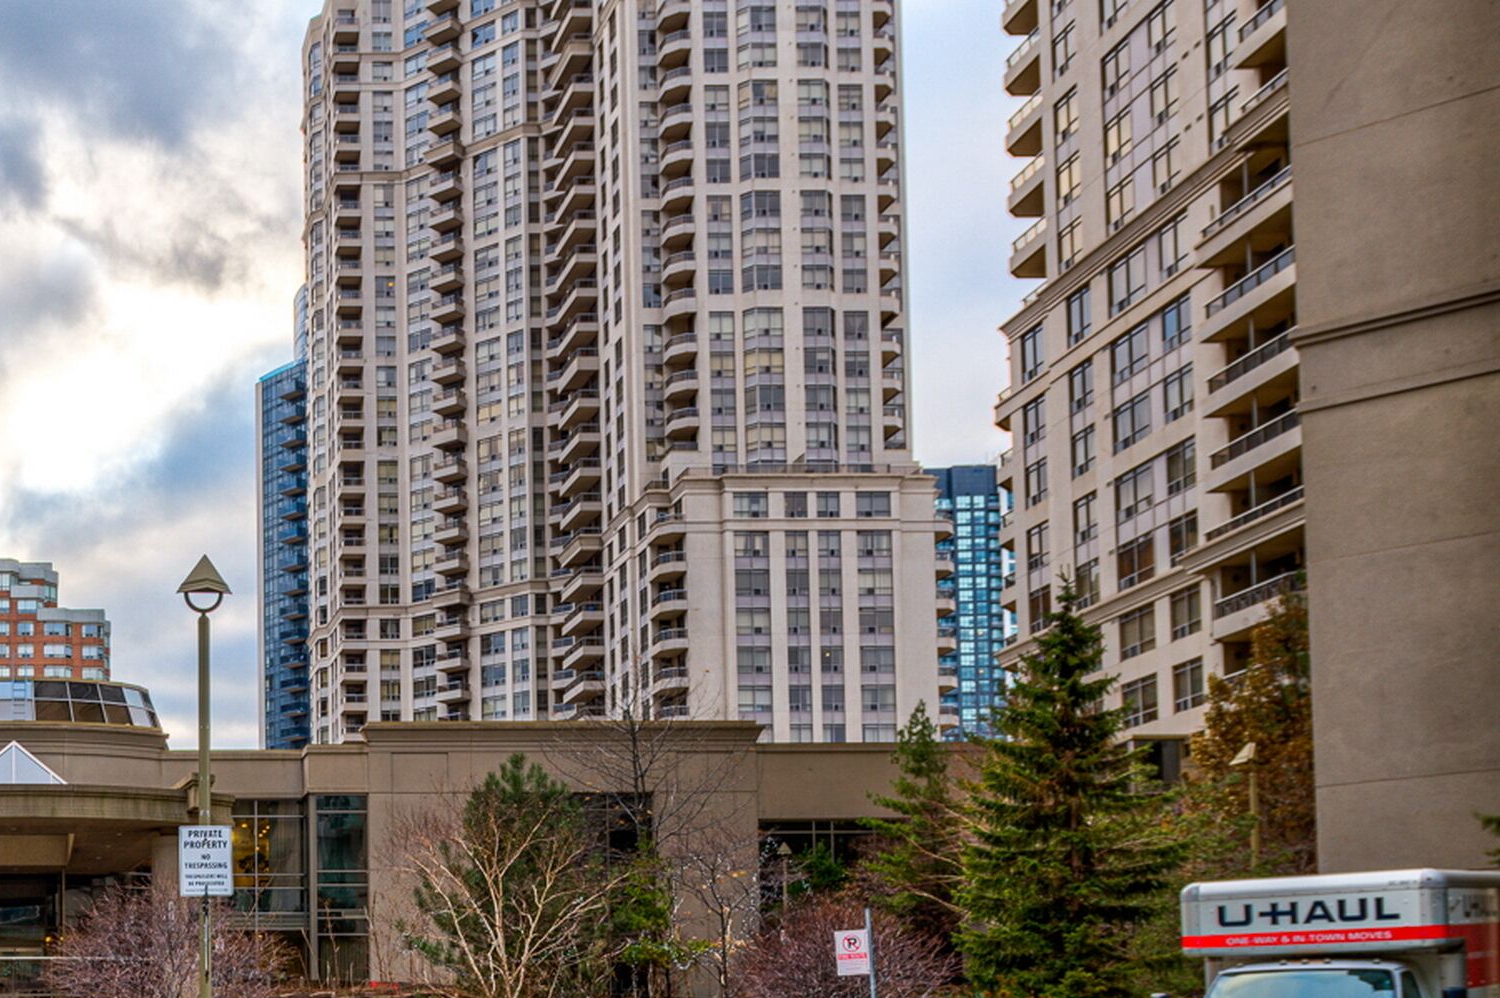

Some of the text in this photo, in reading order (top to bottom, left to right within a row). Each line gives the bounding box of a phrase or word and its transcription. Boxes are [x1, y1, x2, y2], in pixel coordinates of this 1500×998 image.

[188, 830, 222, 838] PRIVATE
[184, 840, 228, 848] PROPERTY
[1217, 897, 1401, 927] U-HAUL
[1347, 930, 1393, 941] MOVES
